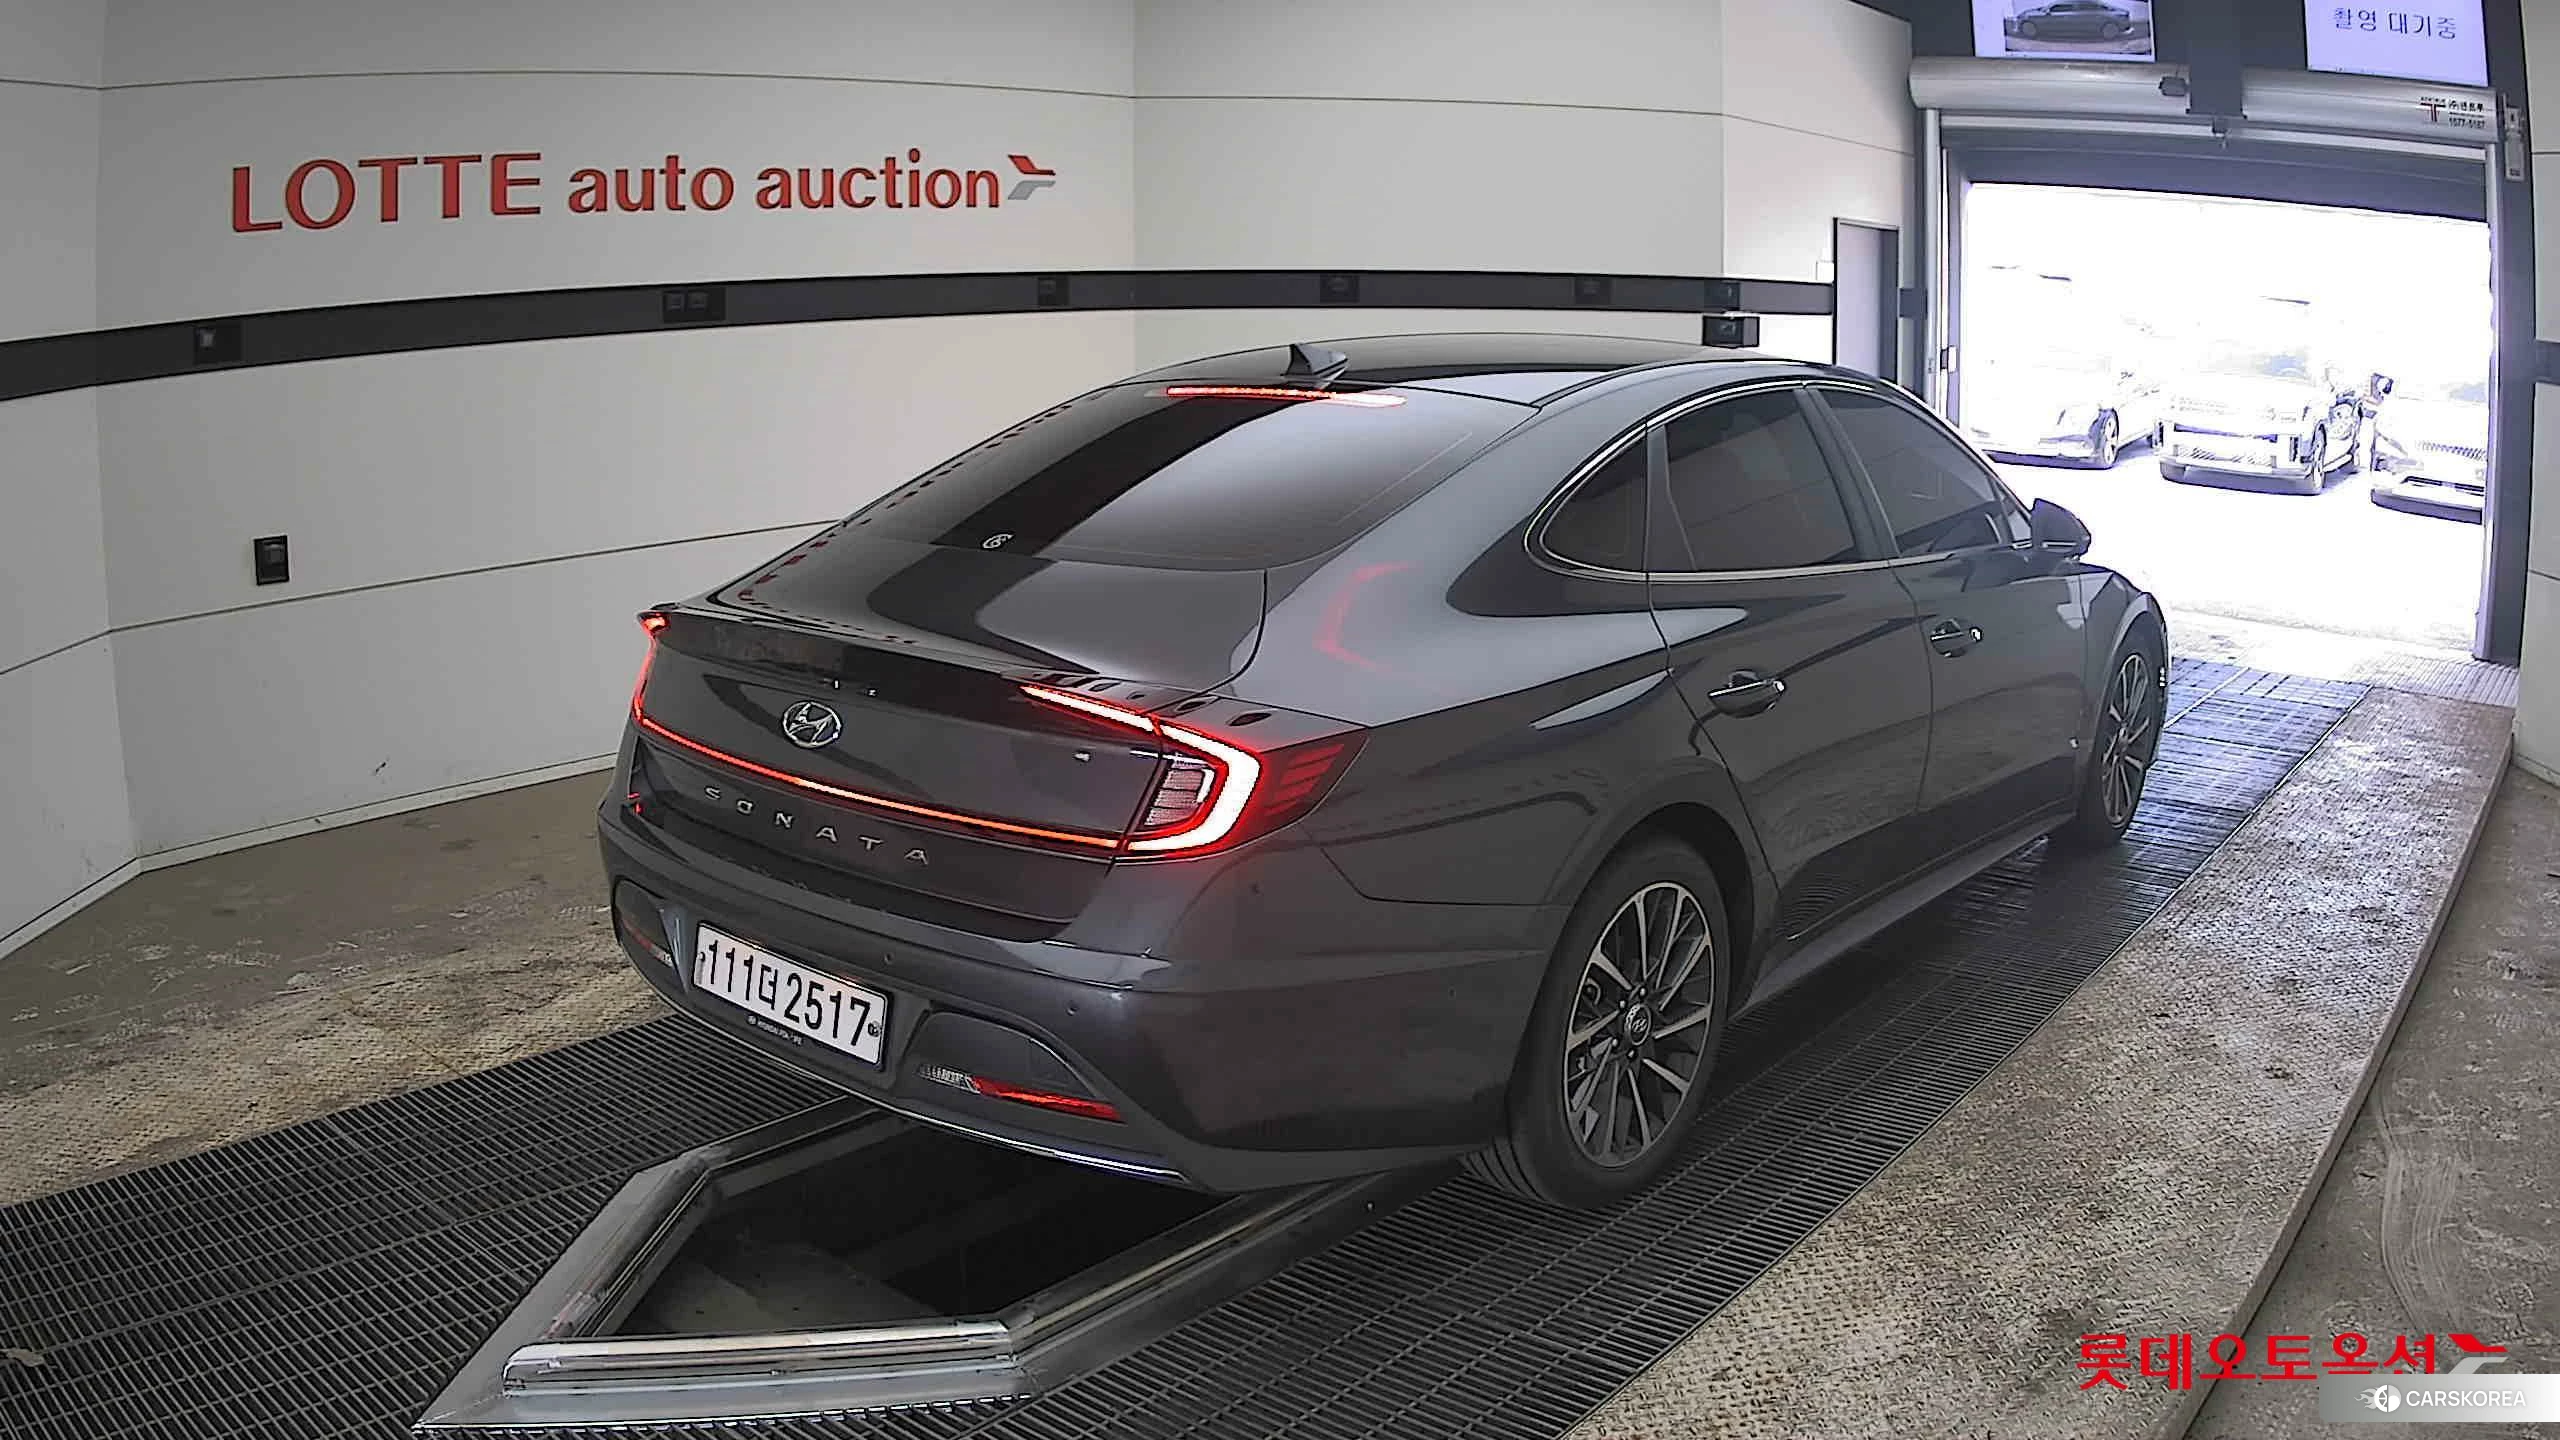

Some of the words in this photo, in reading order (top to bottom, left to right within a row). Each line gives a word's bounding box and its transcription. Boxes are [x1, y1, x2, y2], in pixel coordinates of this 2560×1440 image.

[2388, 13, 2457, 40] 대기중
[232, 152, 541, 233] LOTTE
[568, 155, 734, 213] auto
[756, 147, 1000, 209] auction
[704, 786, 929, 865] SONATA
